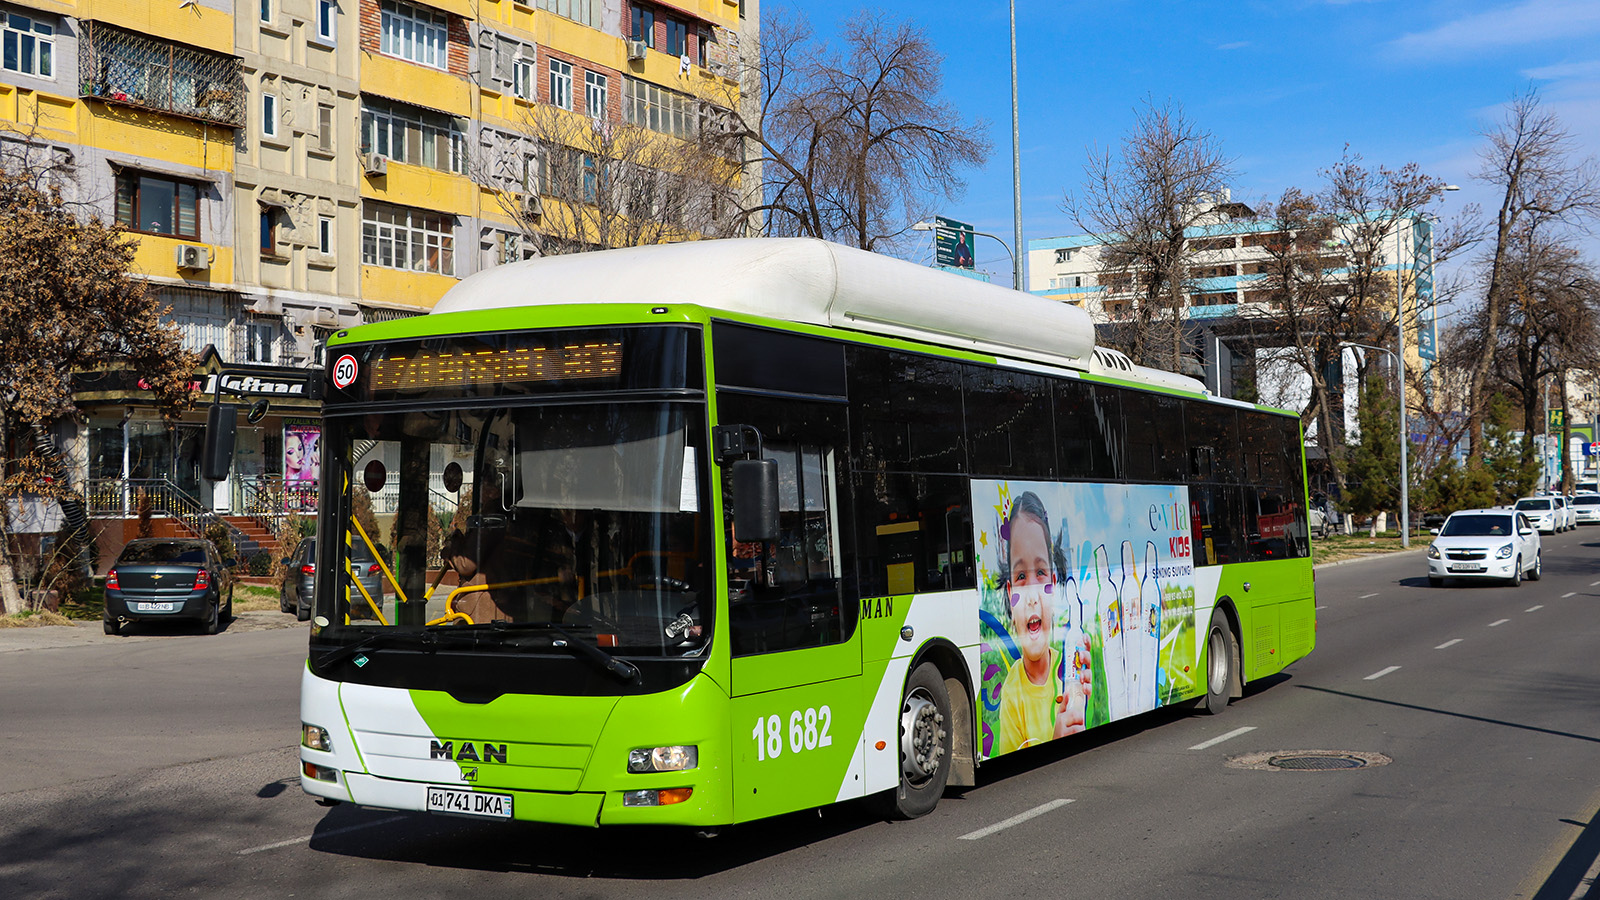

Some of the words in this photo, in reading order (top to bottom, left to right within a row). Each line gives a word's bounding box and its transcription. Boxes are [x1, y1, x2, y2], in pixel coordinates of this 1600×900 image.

[337, 364, 353, 380] 50
[1168, 536, 1190, 559] KIDS
[861, 597, 893, 620] MAN
[752, 714, 782, 762] 18
[789, 705, 832, 754] 682
[430, 740, 507, 763] MAN
[431, 793, 443, 807] 01
[446, 792, 470, 811] 741
[474, 795, 503, 815] DKA
